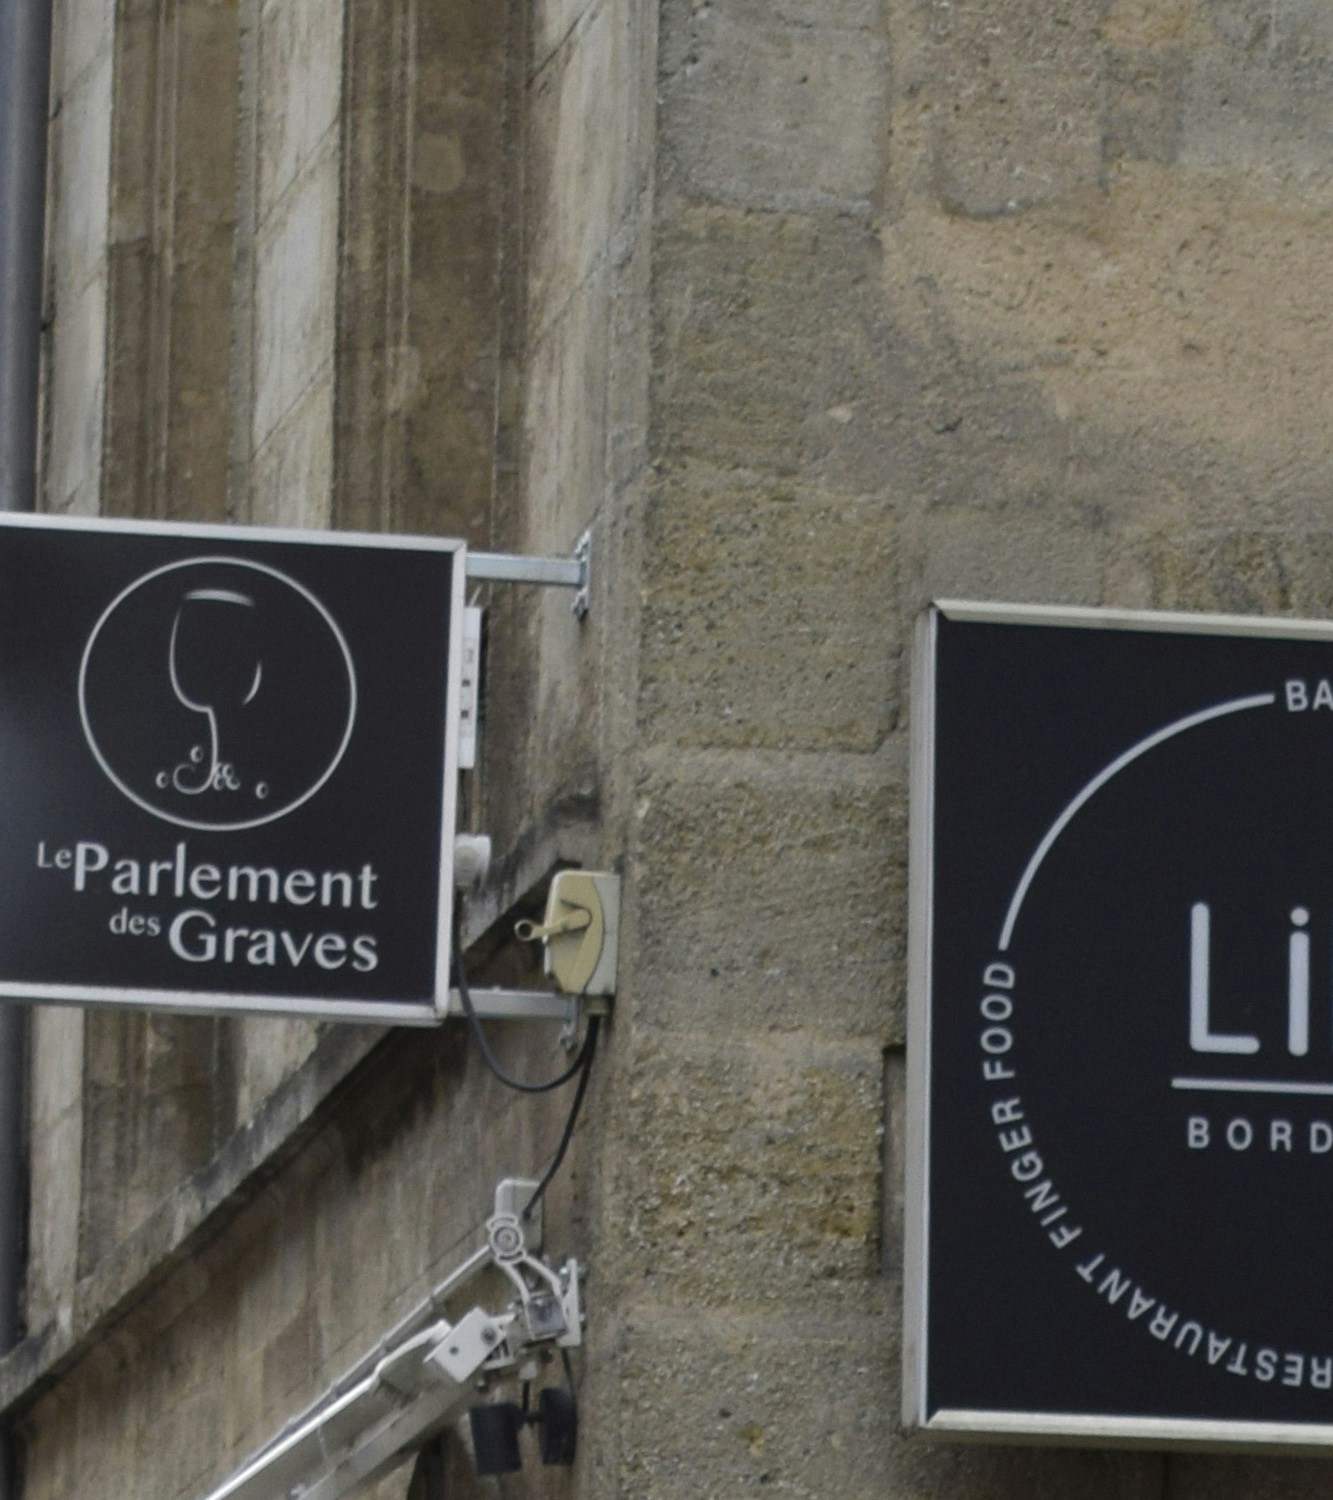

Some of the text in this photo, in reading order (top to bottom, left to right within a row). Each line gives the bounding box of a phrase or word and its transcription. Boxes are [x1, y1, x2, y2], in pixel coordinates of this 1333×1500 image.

[37, 840, 379, 910] Le Parlement
[108, 906, 379, 973] des Graves
[979, 962, 1016, 1081] FOOD
[990, 1098, 1082, 1249] FINGER
[1075, 1254, 1333, 1389] RESTAURANT
